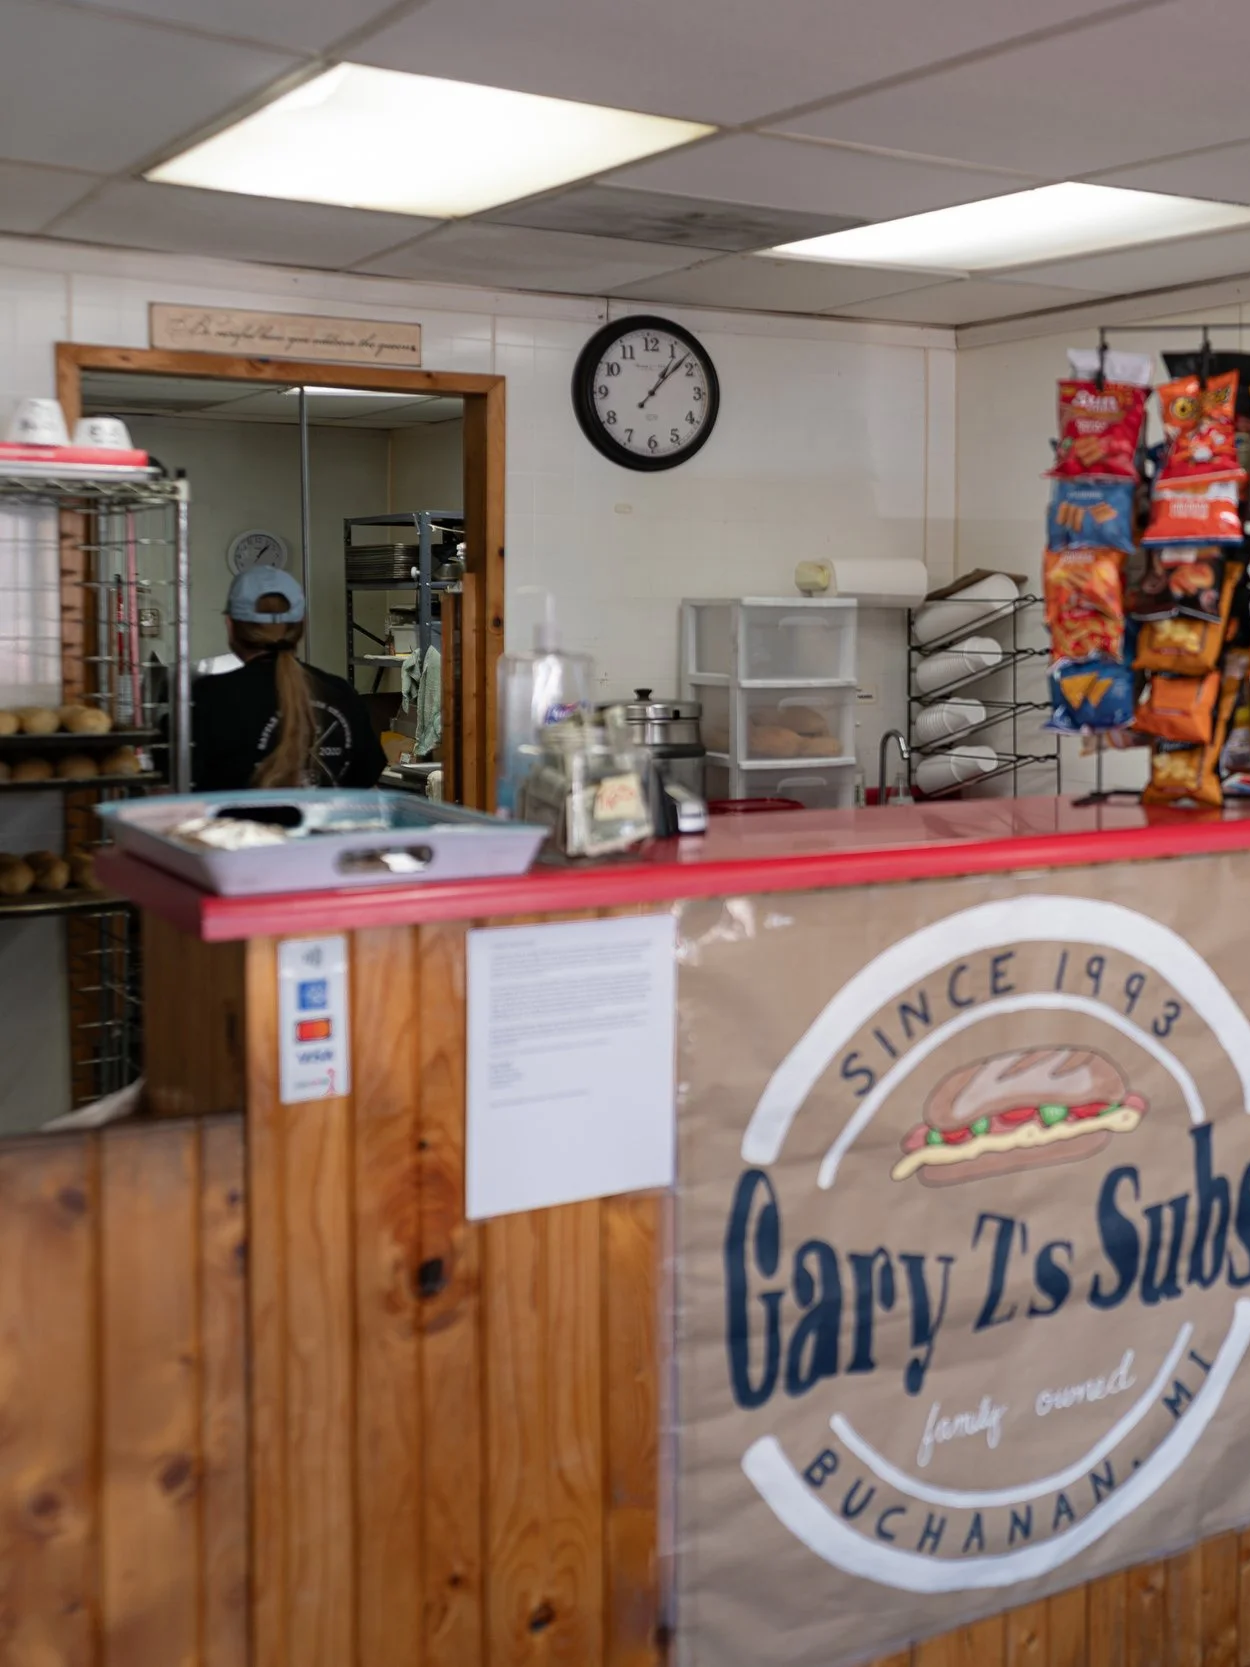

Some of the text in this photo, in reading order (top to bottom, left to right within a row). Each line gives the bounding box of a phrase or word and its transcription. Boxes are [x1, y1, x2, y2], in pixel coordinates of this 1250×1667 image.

[643, 337, 659, 351] 12
[668, 344, 676, 359] 1
[621, 345, 635, 360] 11
[605, 362, 621, 376] 10
[685, 363, 694, 377] 2
[598, 385, 609, 399] 9
[693, 387, 702, 401] 3
[606, 411, 617, 425] 8
[685, 411, 695, 425] 4
[624, 428, 634, 443] 7
[647, 435, 658, 450] 6
[670, 428, 680, 443] 5
[841, 949, 1181, 1097] SINCE 1993
[723, 1168, 956, 1410] Gary
[1035, 1347, 1137, 1416] owned
[1161, 1349, 1213, 1419] MI
